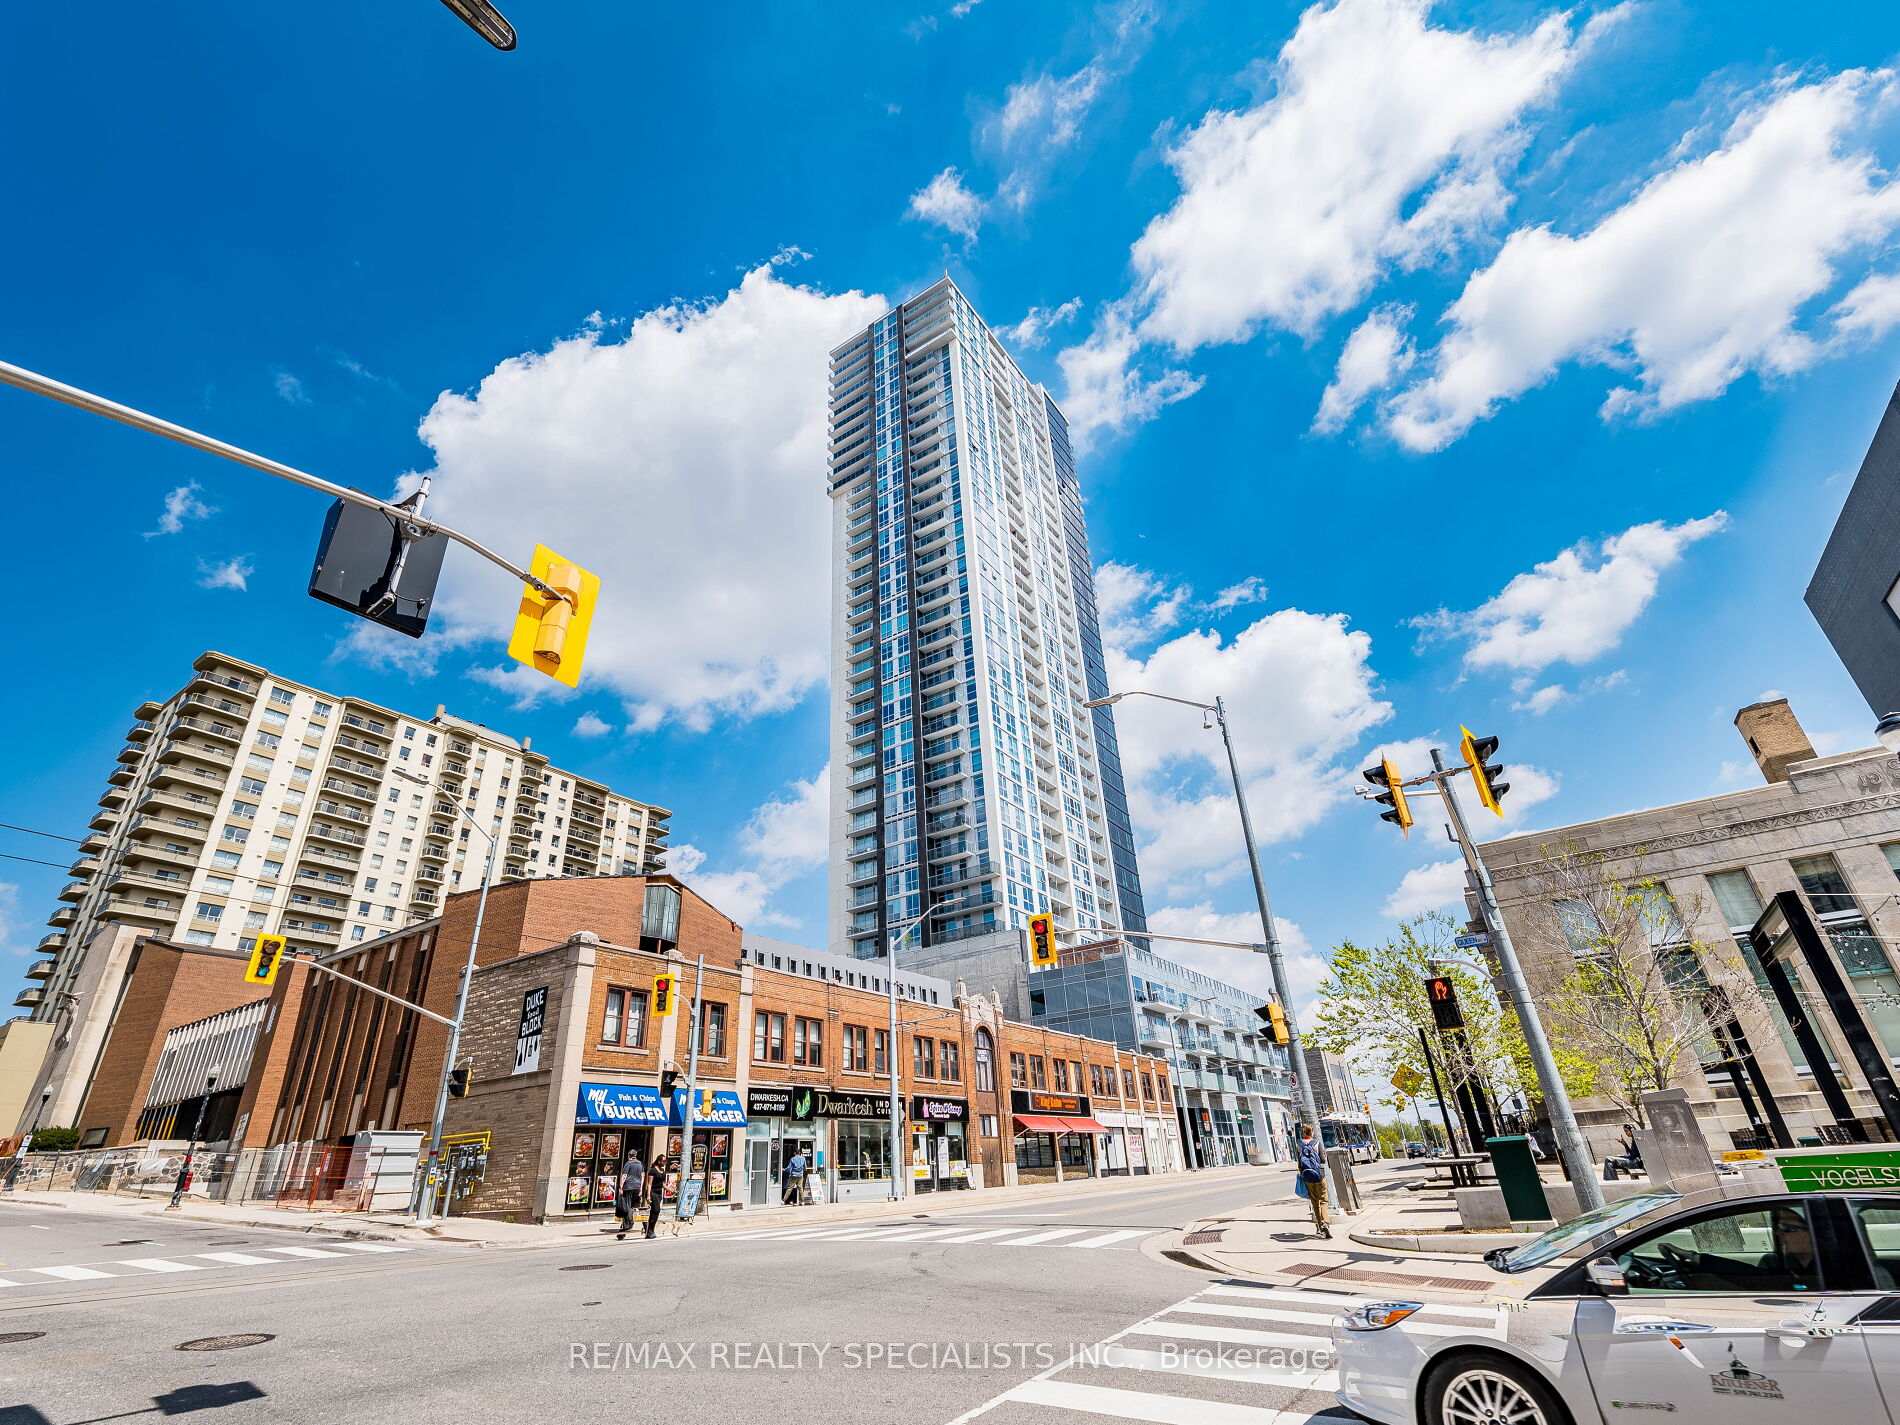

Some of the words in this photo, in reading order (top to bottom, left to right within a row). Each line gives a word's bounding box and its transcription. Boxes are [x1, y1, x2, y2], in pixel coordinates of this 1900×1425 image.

[526, 989, 544, 1012] DUKE
[521, 1014, 542, 1037] BLOCK
[618, 1094, 631, 1102] Fish
[639, 1095, 656, 1104] Chips
[750, 1093, 789, 1102] DWARKESH.CA
[817, 1094, 874, 1116] Dwarkesh
[875, 1100, 903, 1108] INDN
[604, 1105, 666, 1121] BURGER
[1811, 1167, 1900, 1188] VOGELS
[1709, 1374, 1783, 1392] KITCHENER
